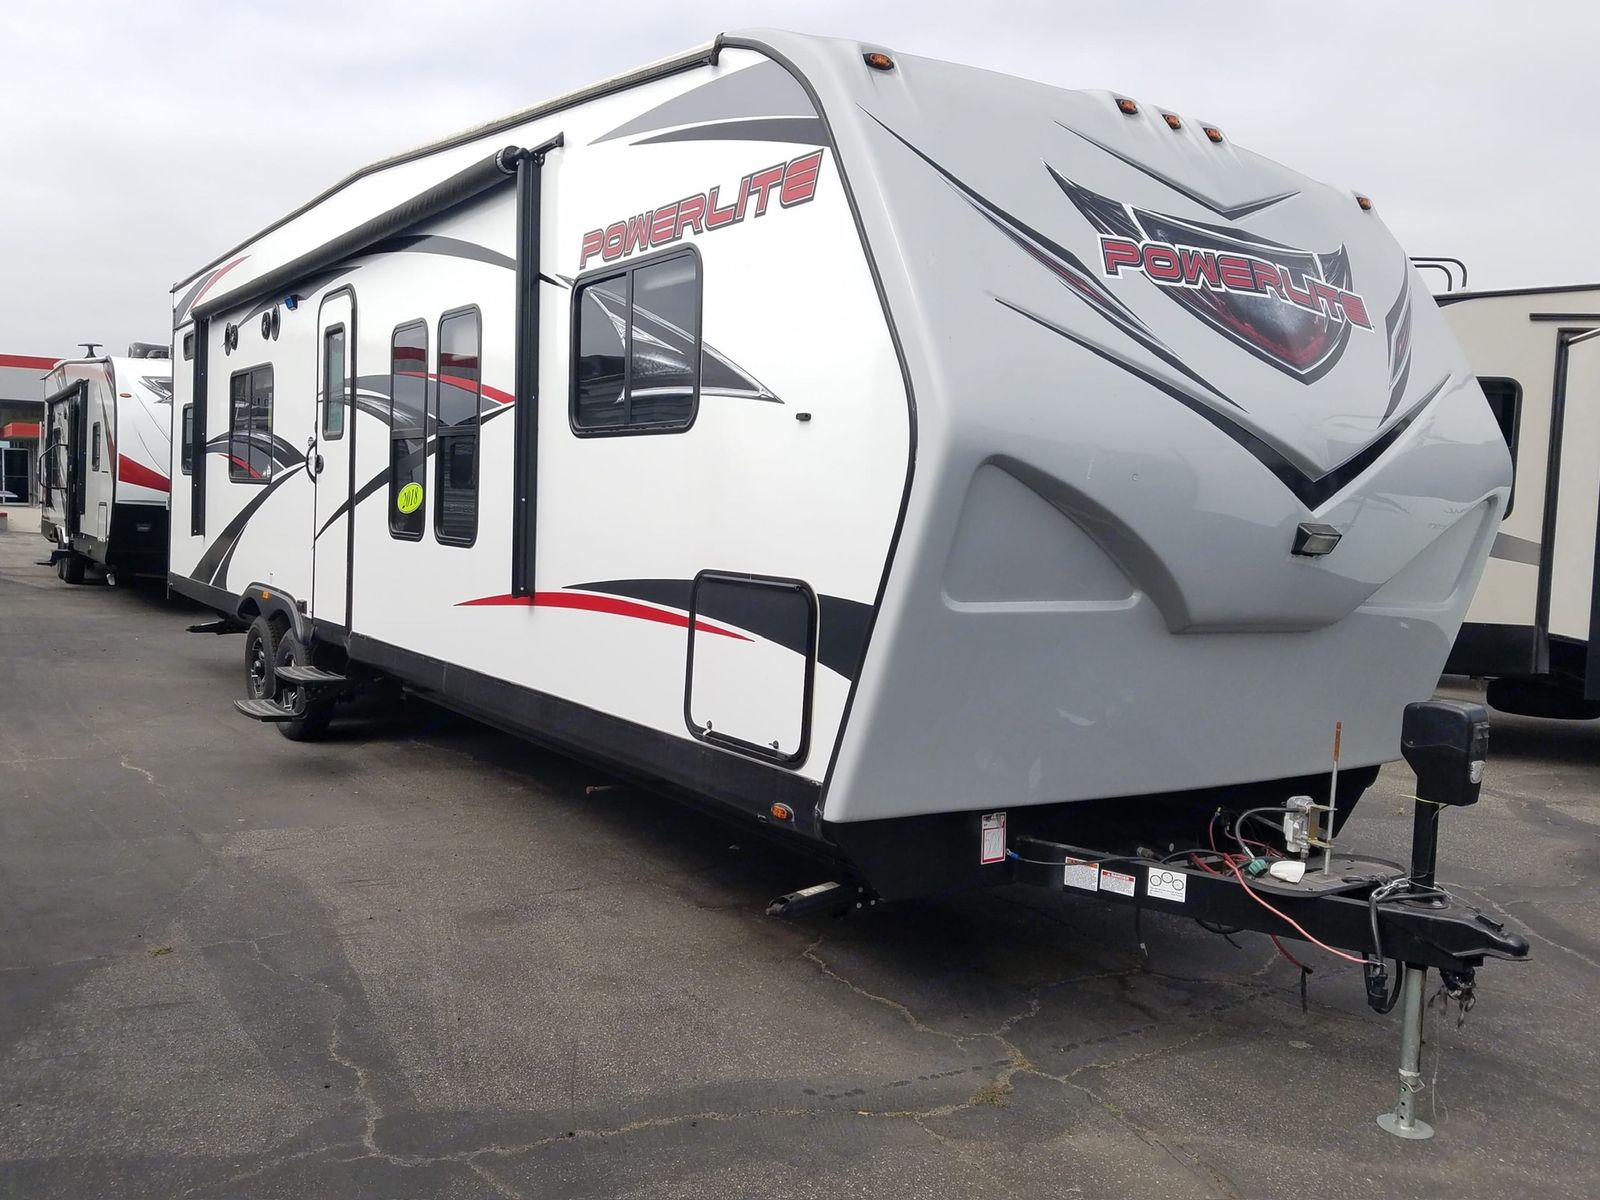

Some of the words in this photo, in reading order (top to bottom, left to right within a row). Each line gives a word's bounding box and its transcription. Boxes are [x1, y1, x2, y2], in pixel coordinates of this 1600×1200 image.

[579, 148, 824, 270] POWERLITE
[1098, 233, 1374, 333] POWERLITE
[401, 486, 419, 509] 2018
